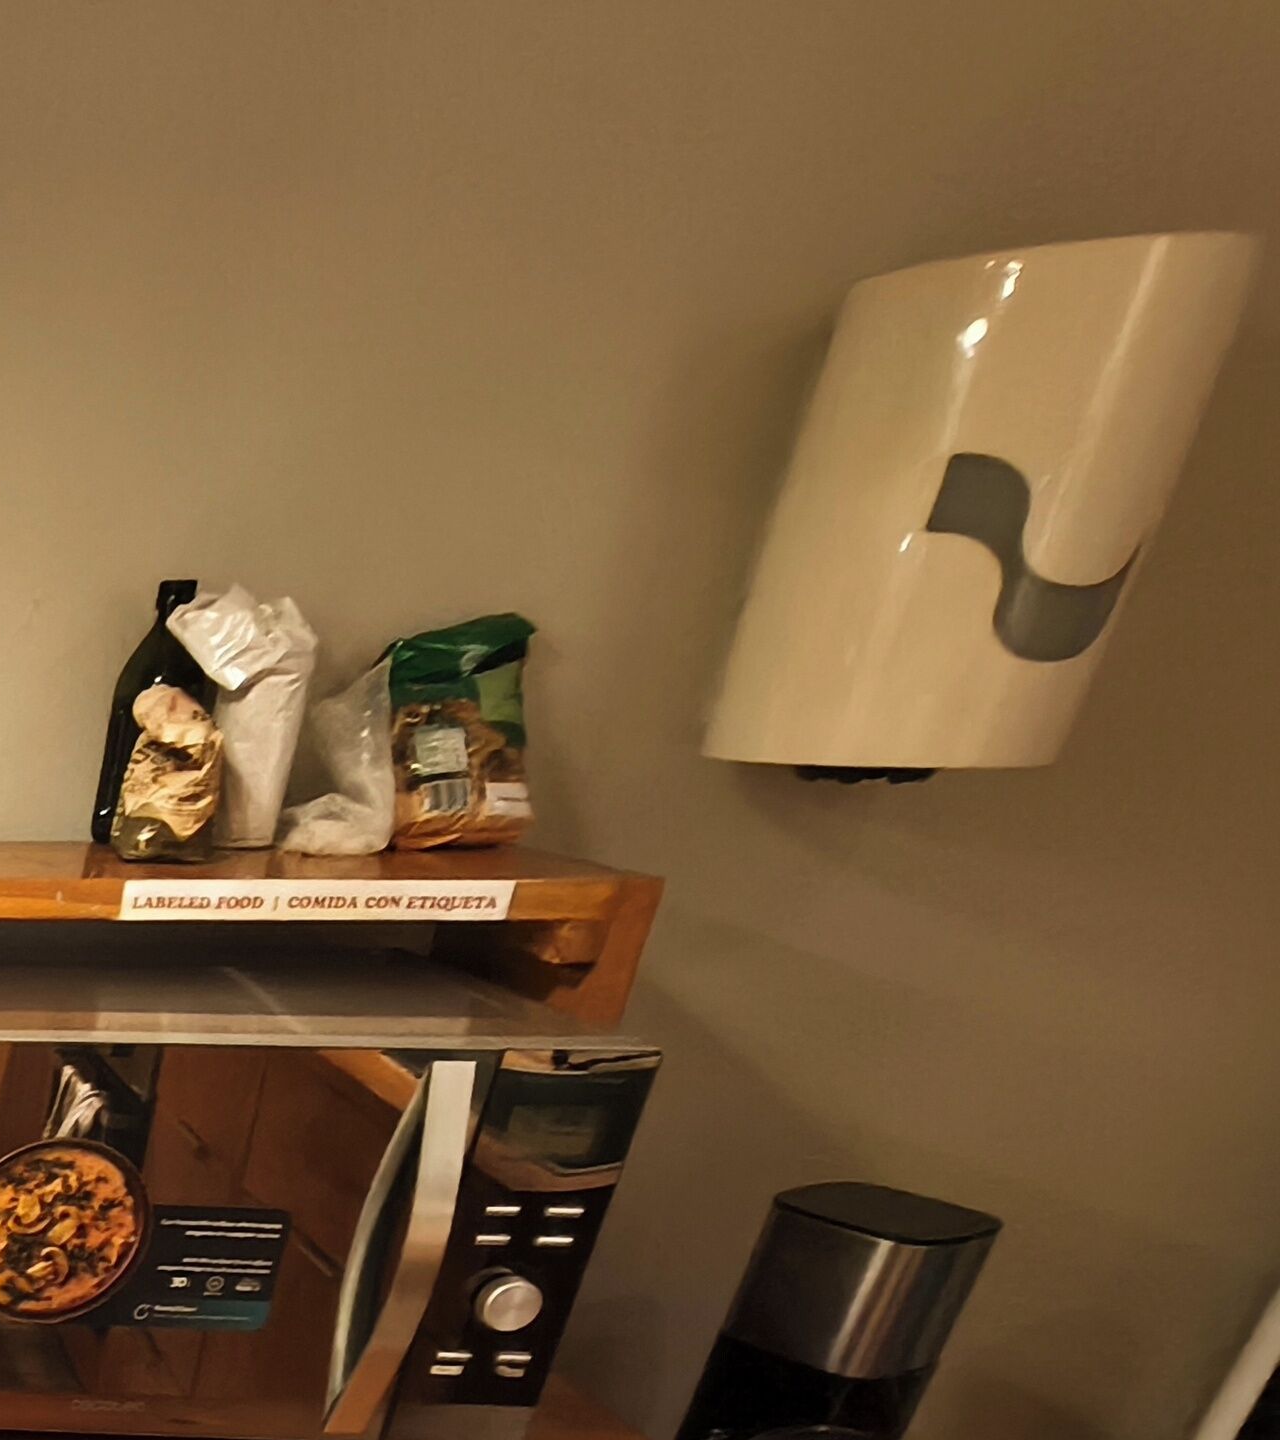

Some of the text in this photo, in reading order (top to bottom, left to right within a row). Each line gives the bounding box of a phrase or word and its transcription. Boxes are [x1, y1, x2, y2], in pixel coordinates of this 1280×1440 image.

[132, 896, 211, 909] LABELED
[215, 896, 264, 909] FOOD
[287, 896, 358, 909] COMIDA
[364, 896, 403, 909] CON
[406, 896, 497, 911] ETIQUETA
